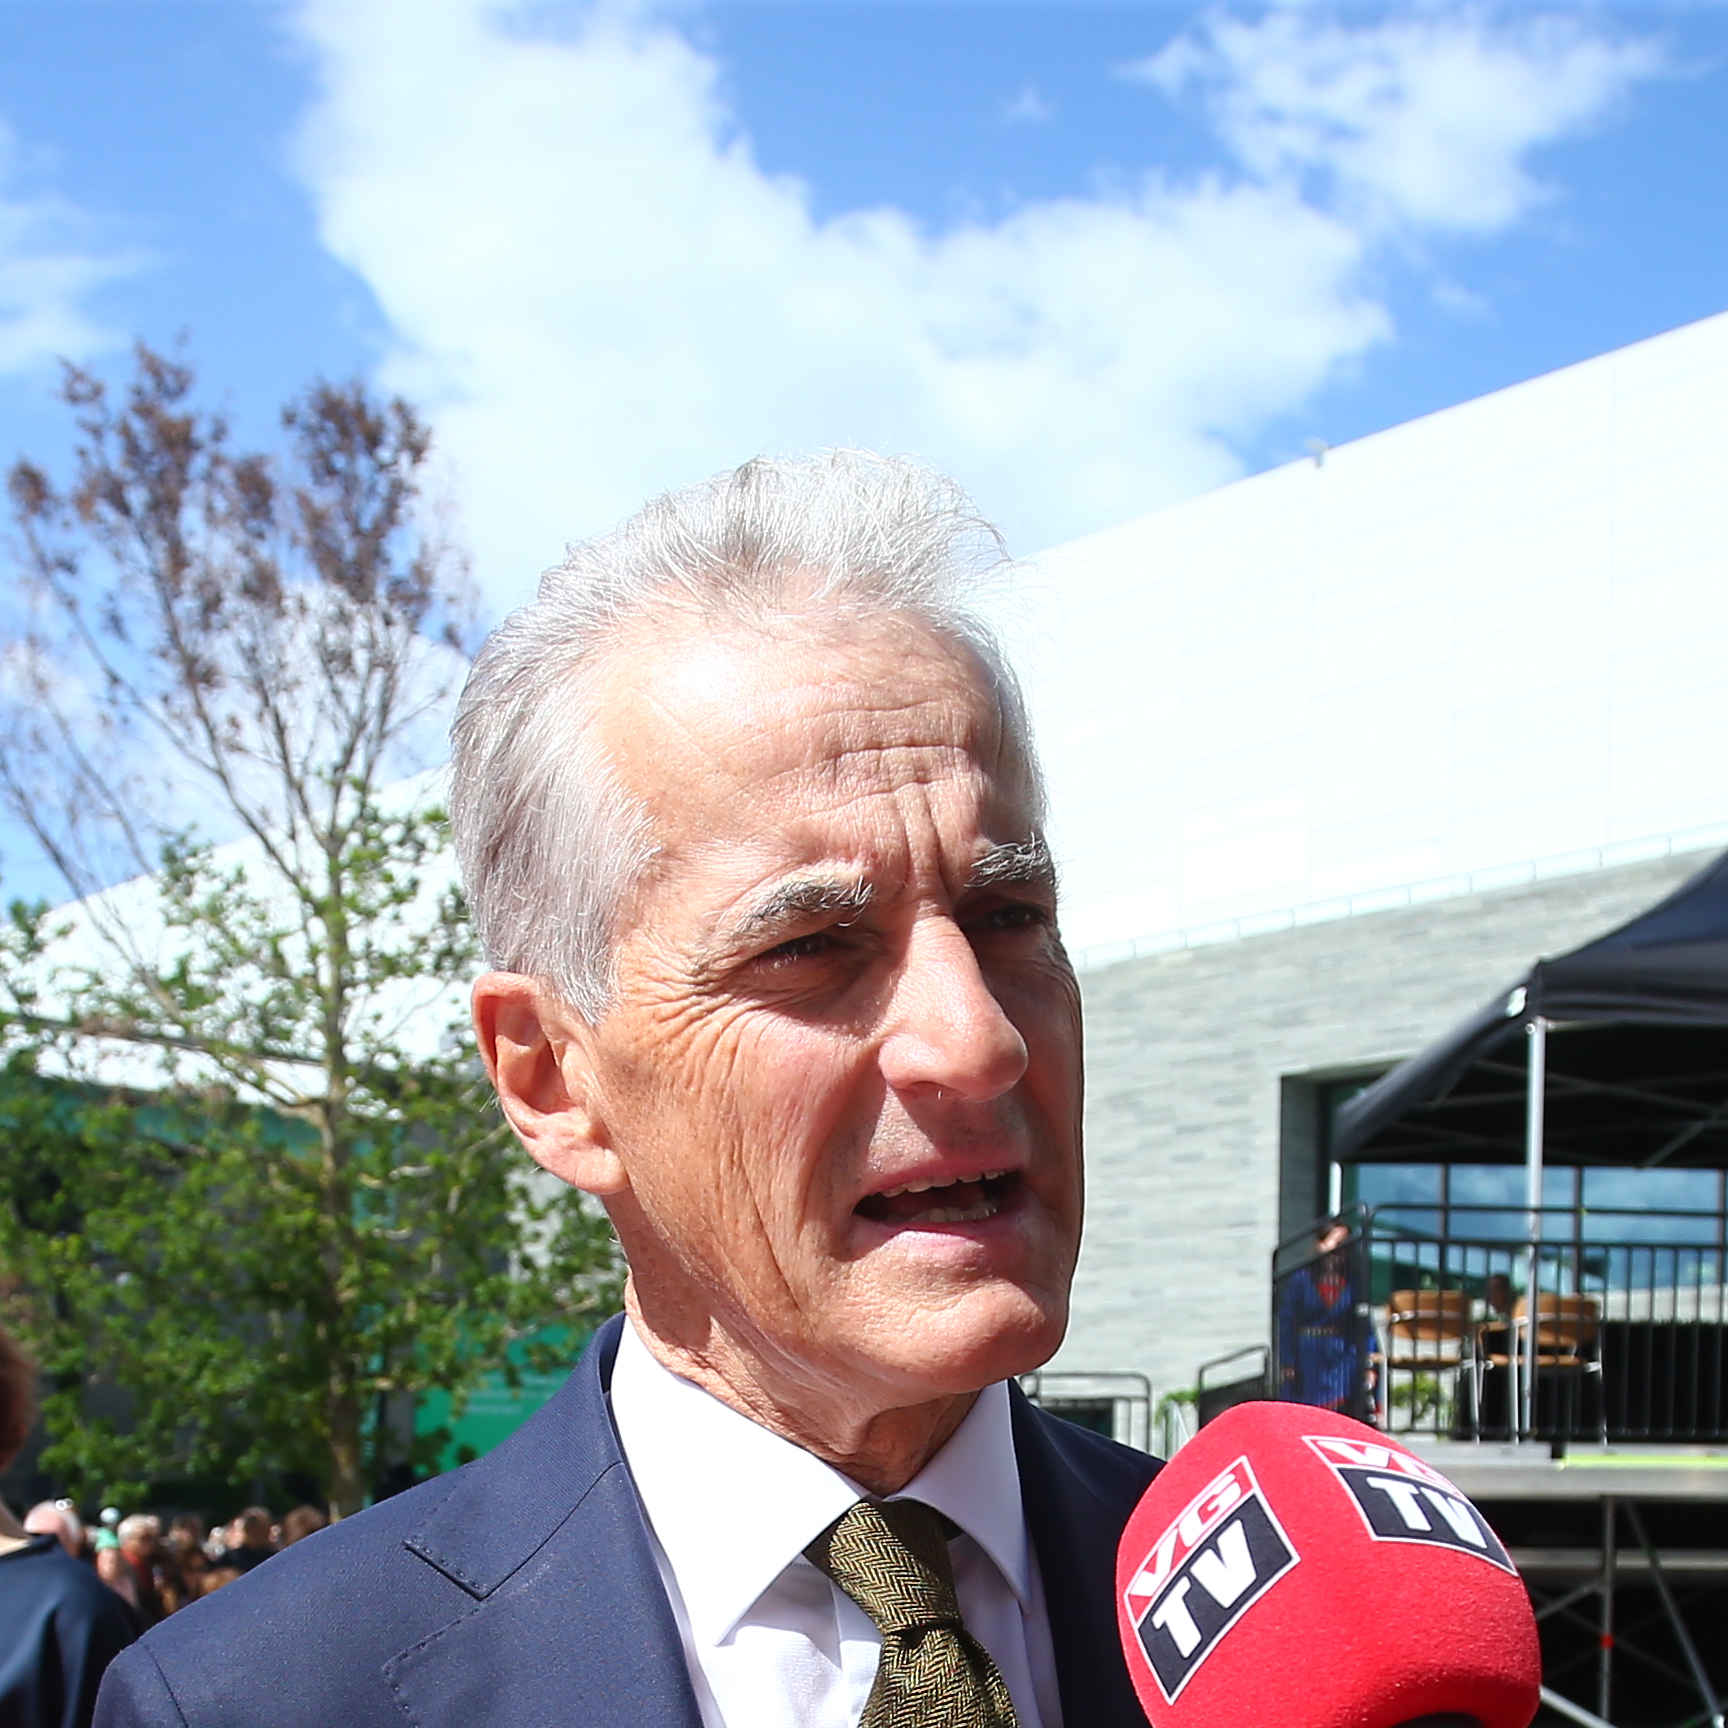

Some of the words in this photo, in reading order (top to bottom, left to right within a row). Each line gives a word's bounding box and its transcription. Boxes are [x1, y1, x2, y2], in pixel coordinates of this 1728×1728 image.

[1317, 1440, 1464, 1498] VG
[1366, 1477, 1488, 1549] TV
[1130, 1473, 1242, 1597] VG
[1151, 1519, 1257, 1658] TV
